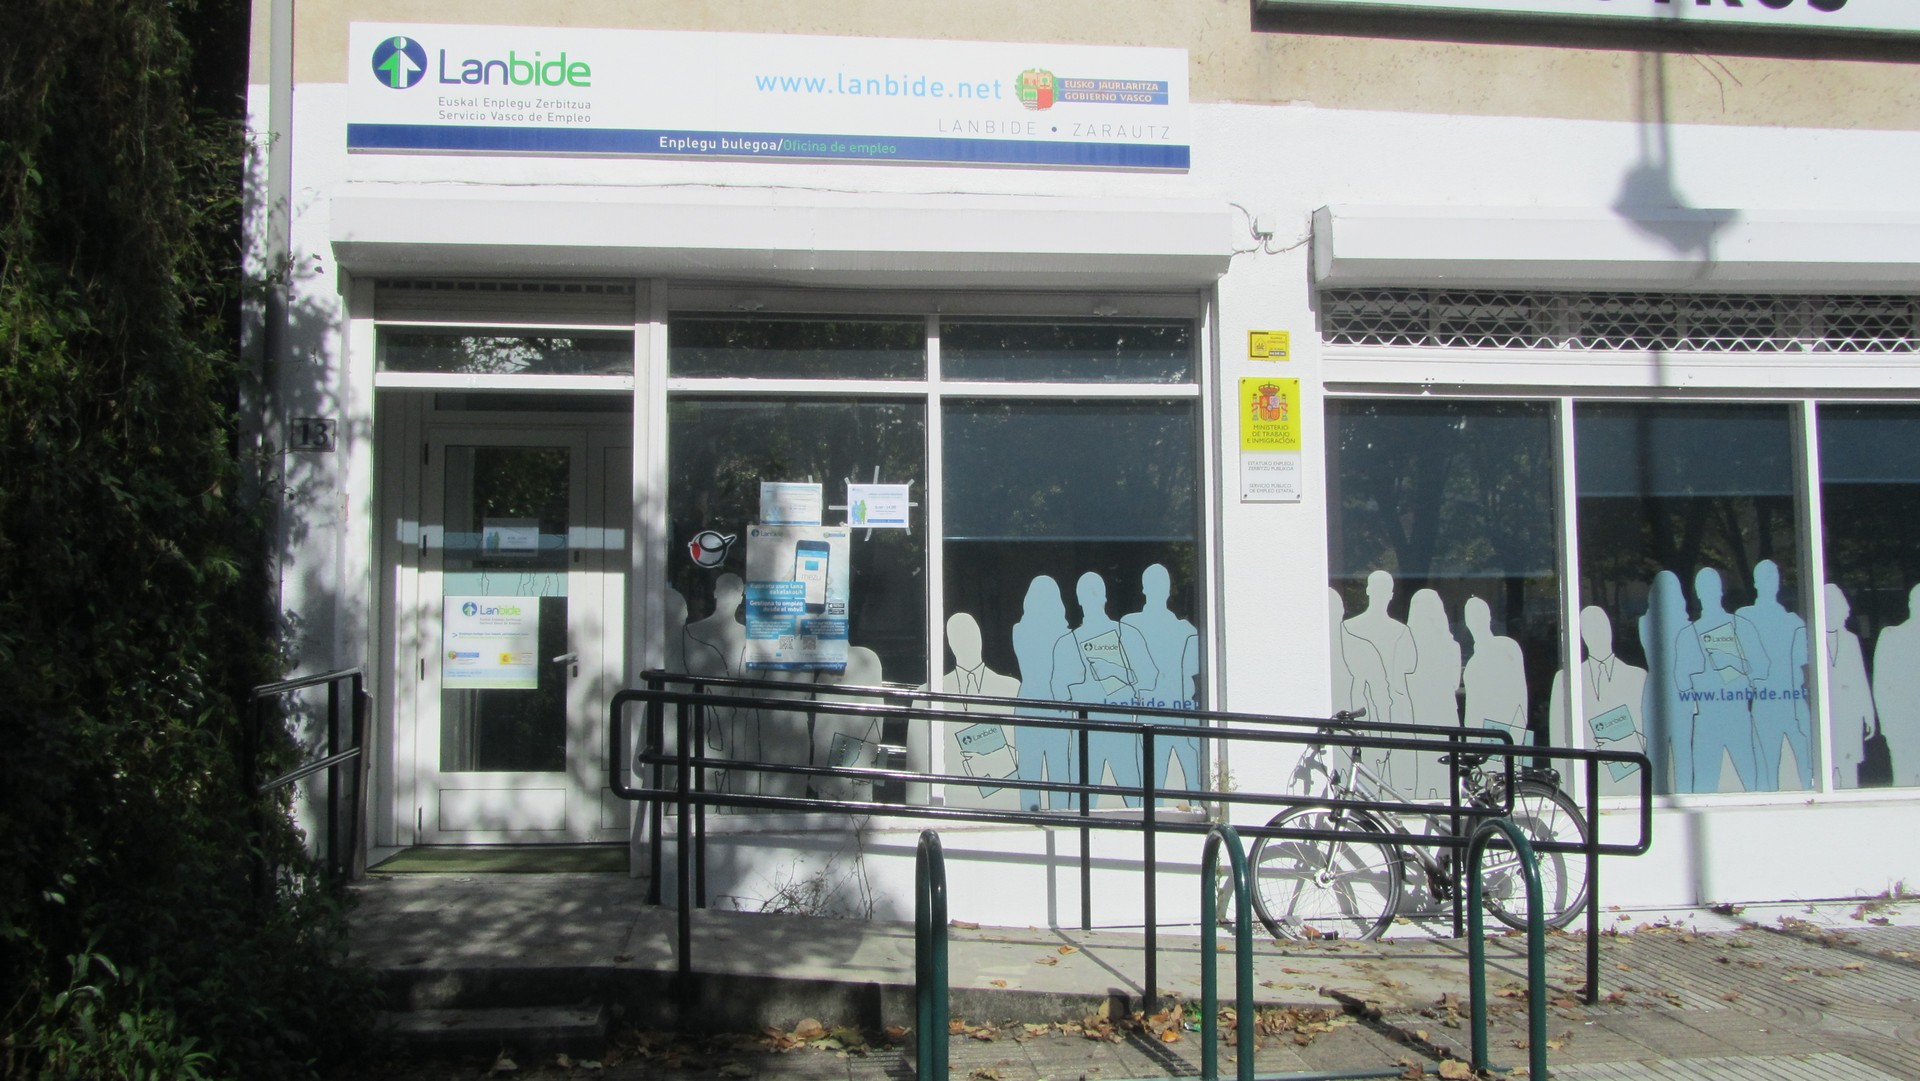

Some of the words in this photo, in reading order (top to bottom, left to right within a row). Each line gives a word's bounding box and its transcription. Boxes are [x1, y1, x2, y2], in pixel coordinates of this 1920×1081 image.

[440, 49, 591, 87] Lanbide
[755, 73, 1001, 99] www.lanbide.net
[1065, 80, 1094, 89] EUSKO
[1098, 82, 1158, 91] JAURLARITZA
[439, 97, 478, 107] Euskal
[484, 98, 531, 110] Enplegu
[536, 99, 591, 109] Zerbitzua
[1065, 92, 1117, 101] GOBIERNO
[1120, 94, 1152, 102] VASCO
[439, 110, 486, 120] Servicio
[491, 111, 524, 121] Vasco
[529, 112, 542, 122] de
[548, 113, 591, 124] Empleo
[939, 119, 1036, 135] LANBIDE
[1073, 123, 1170, 140] ZARAUTZ
[660, 137, 716, 151] Enplegu
[831, 141, 846, 153] de
[849, 144, 897, 156] empleo
[302, 423, 328, 446] 13
[480, 605, 521, 615] Lanbide
[1094, 643, 1119, 651] Lanbide
[973, 727, 998, 741] Lanbide
